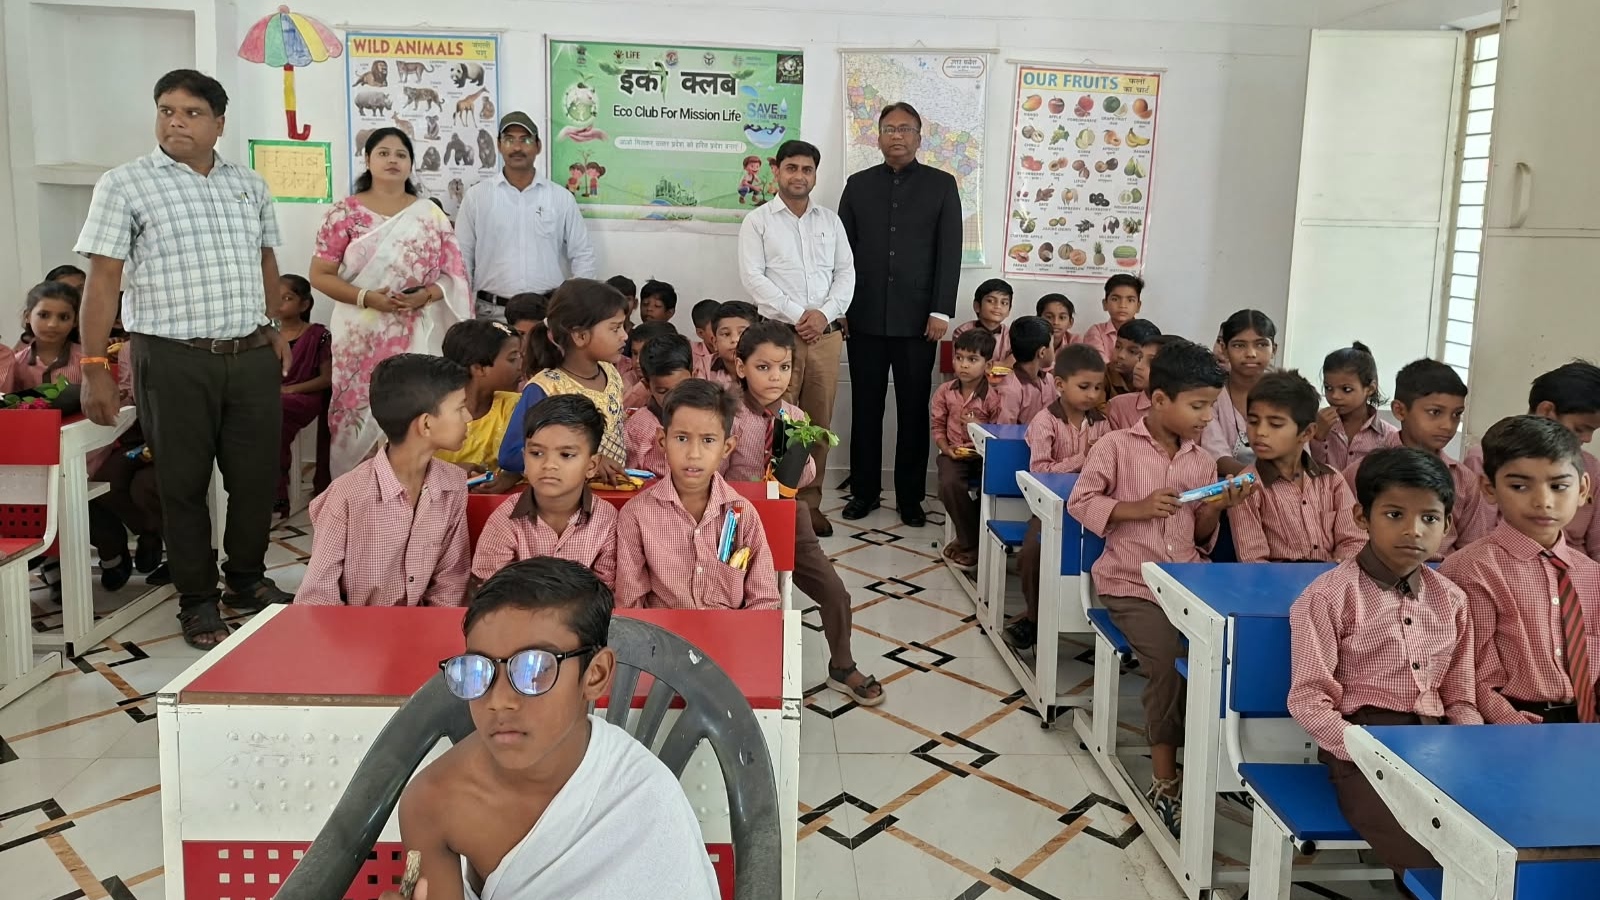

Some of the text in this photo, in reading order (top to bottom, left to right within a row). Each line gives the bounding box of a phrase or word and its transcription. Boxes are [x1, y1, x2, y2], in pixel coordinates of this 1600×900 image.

[353, 38, 464, 56] WILD ANIMALS
[680, 71, 737, 96] क्लब
[1023, 71, 1119, 90] OUR FRUITS
[613, 104, 742, 122] Eco Club For Mission Life
[747, 102, 778, 118] SAVE
